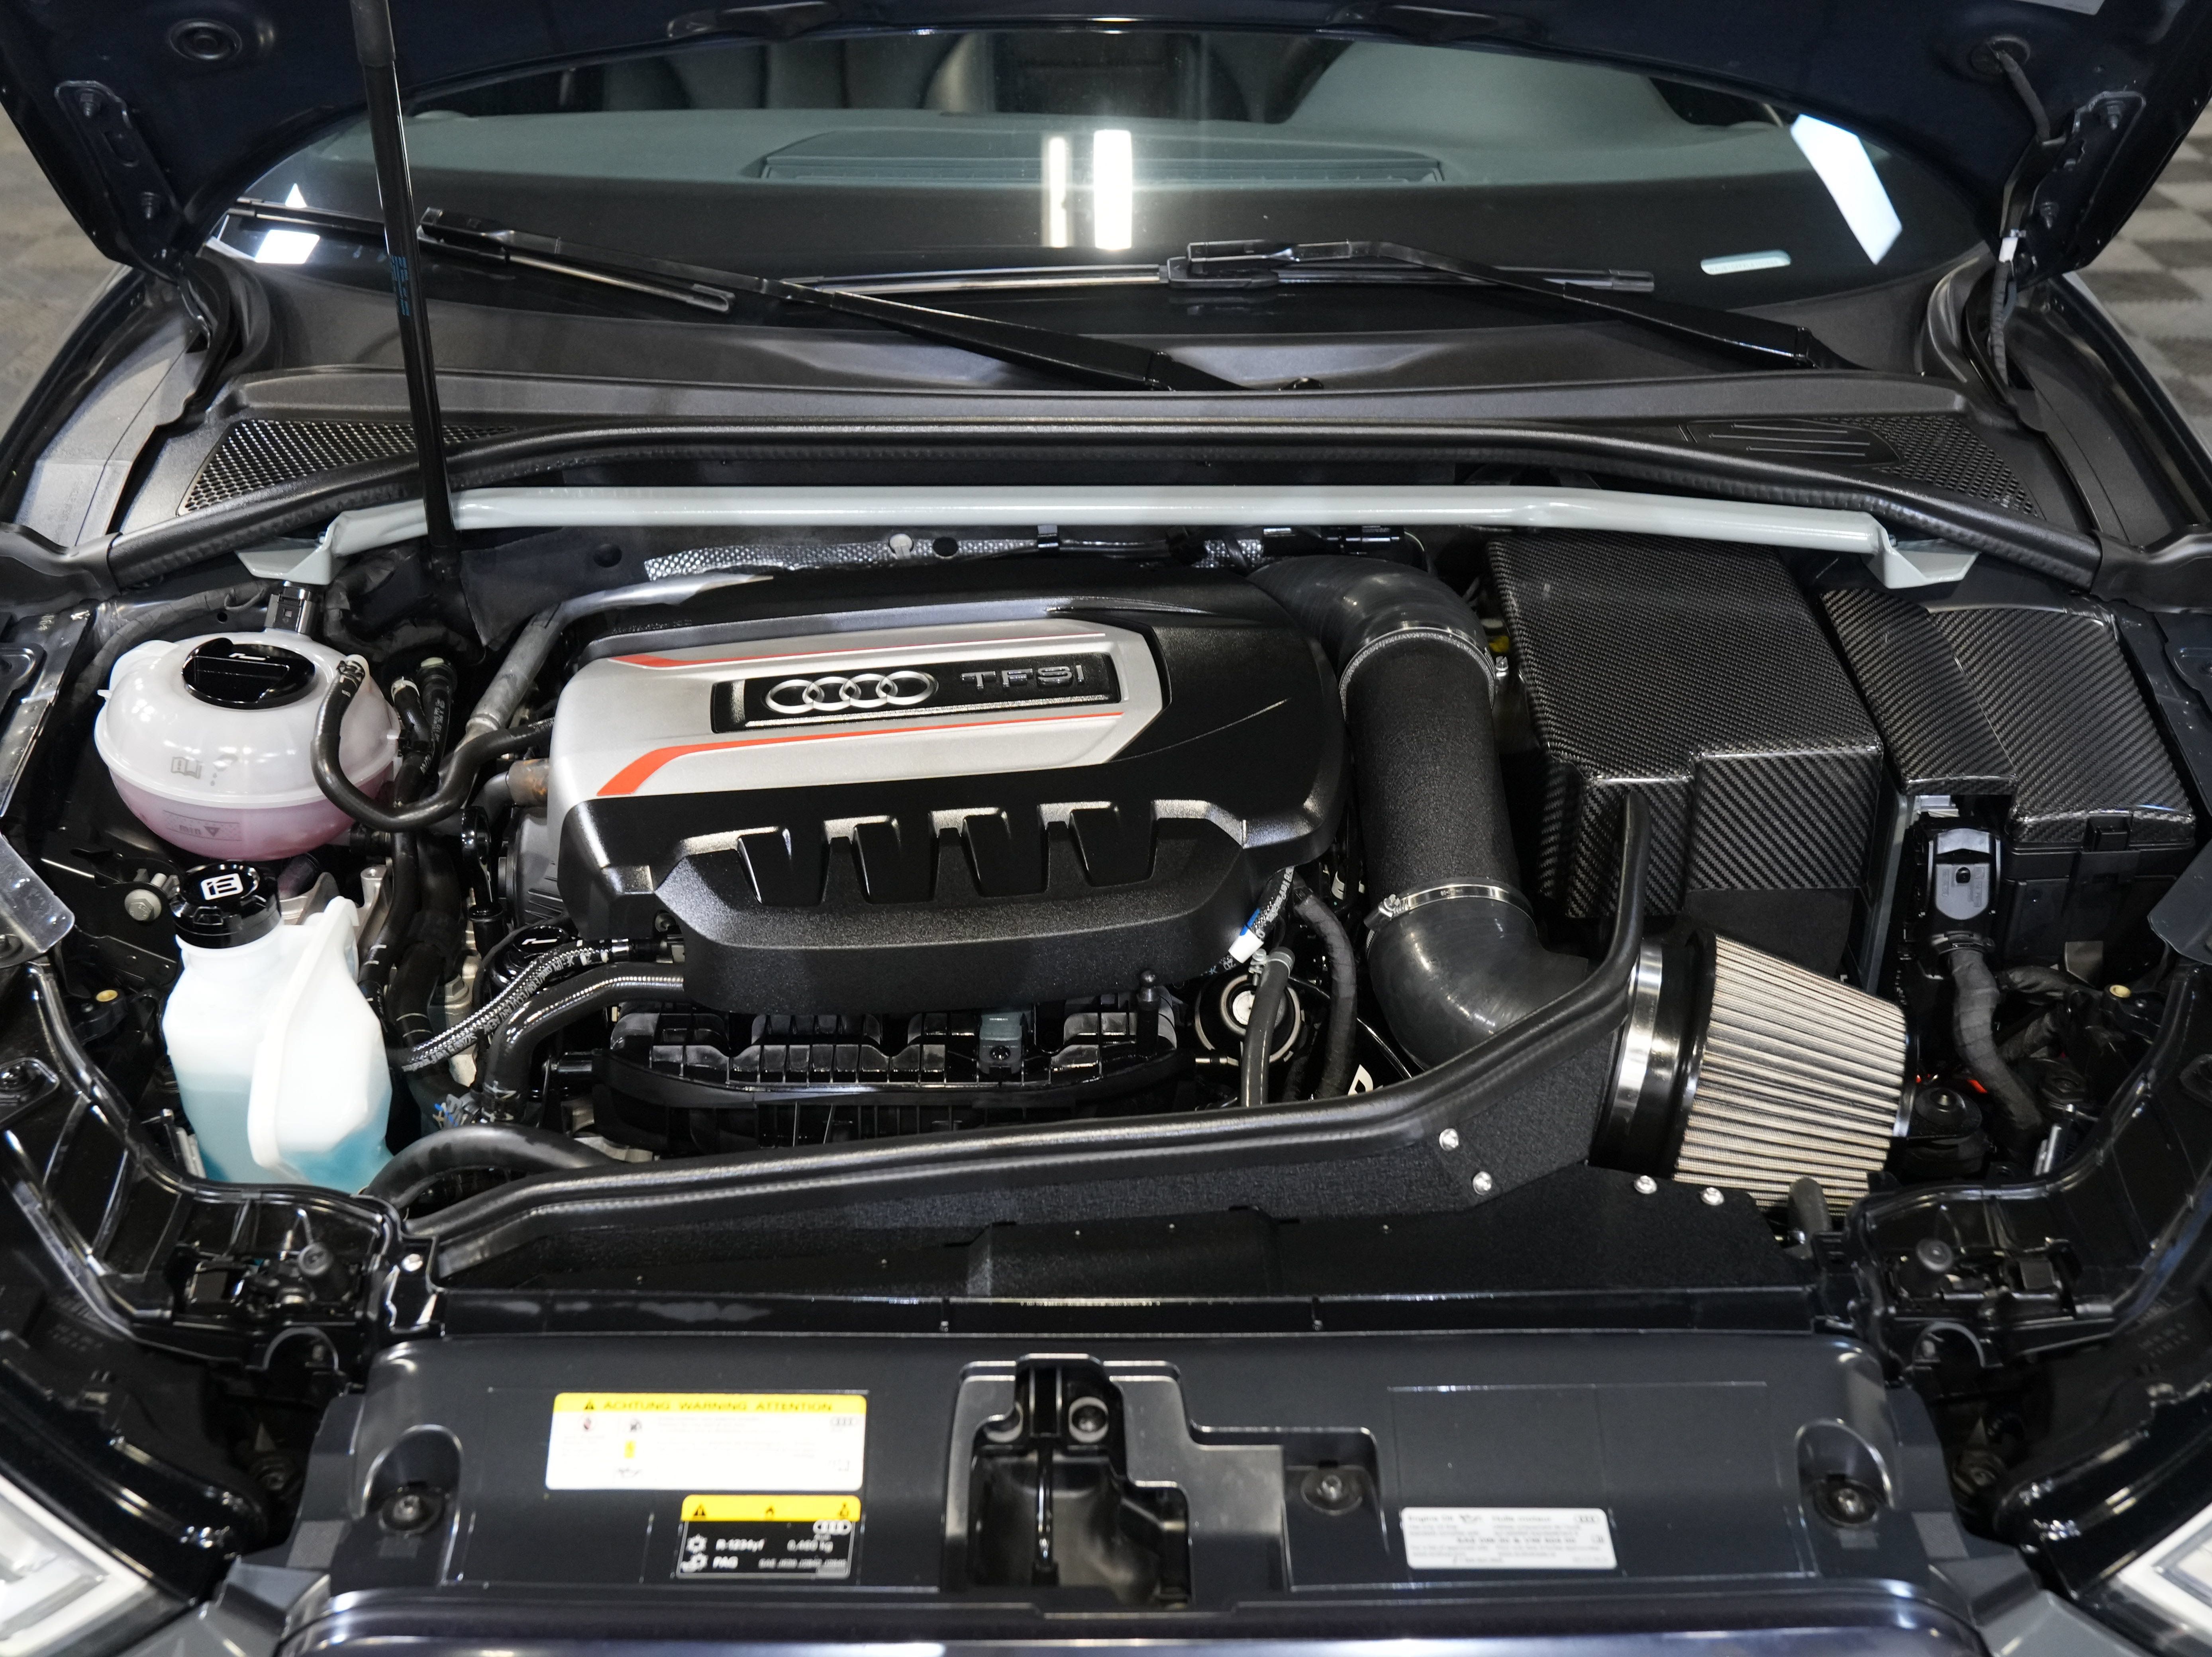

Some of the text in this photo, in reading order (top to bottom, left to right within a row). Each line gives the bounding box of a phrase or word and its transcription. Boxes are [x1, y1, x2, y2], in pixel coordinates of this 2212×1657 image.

[961, 664, 1084, 691] TFSI
[179, 825, 201, 835] min
[603, 1401, 832, 1412] ACHTUNG WARNING ATTENTION
[712, 1556, 739, 1569] PAG
